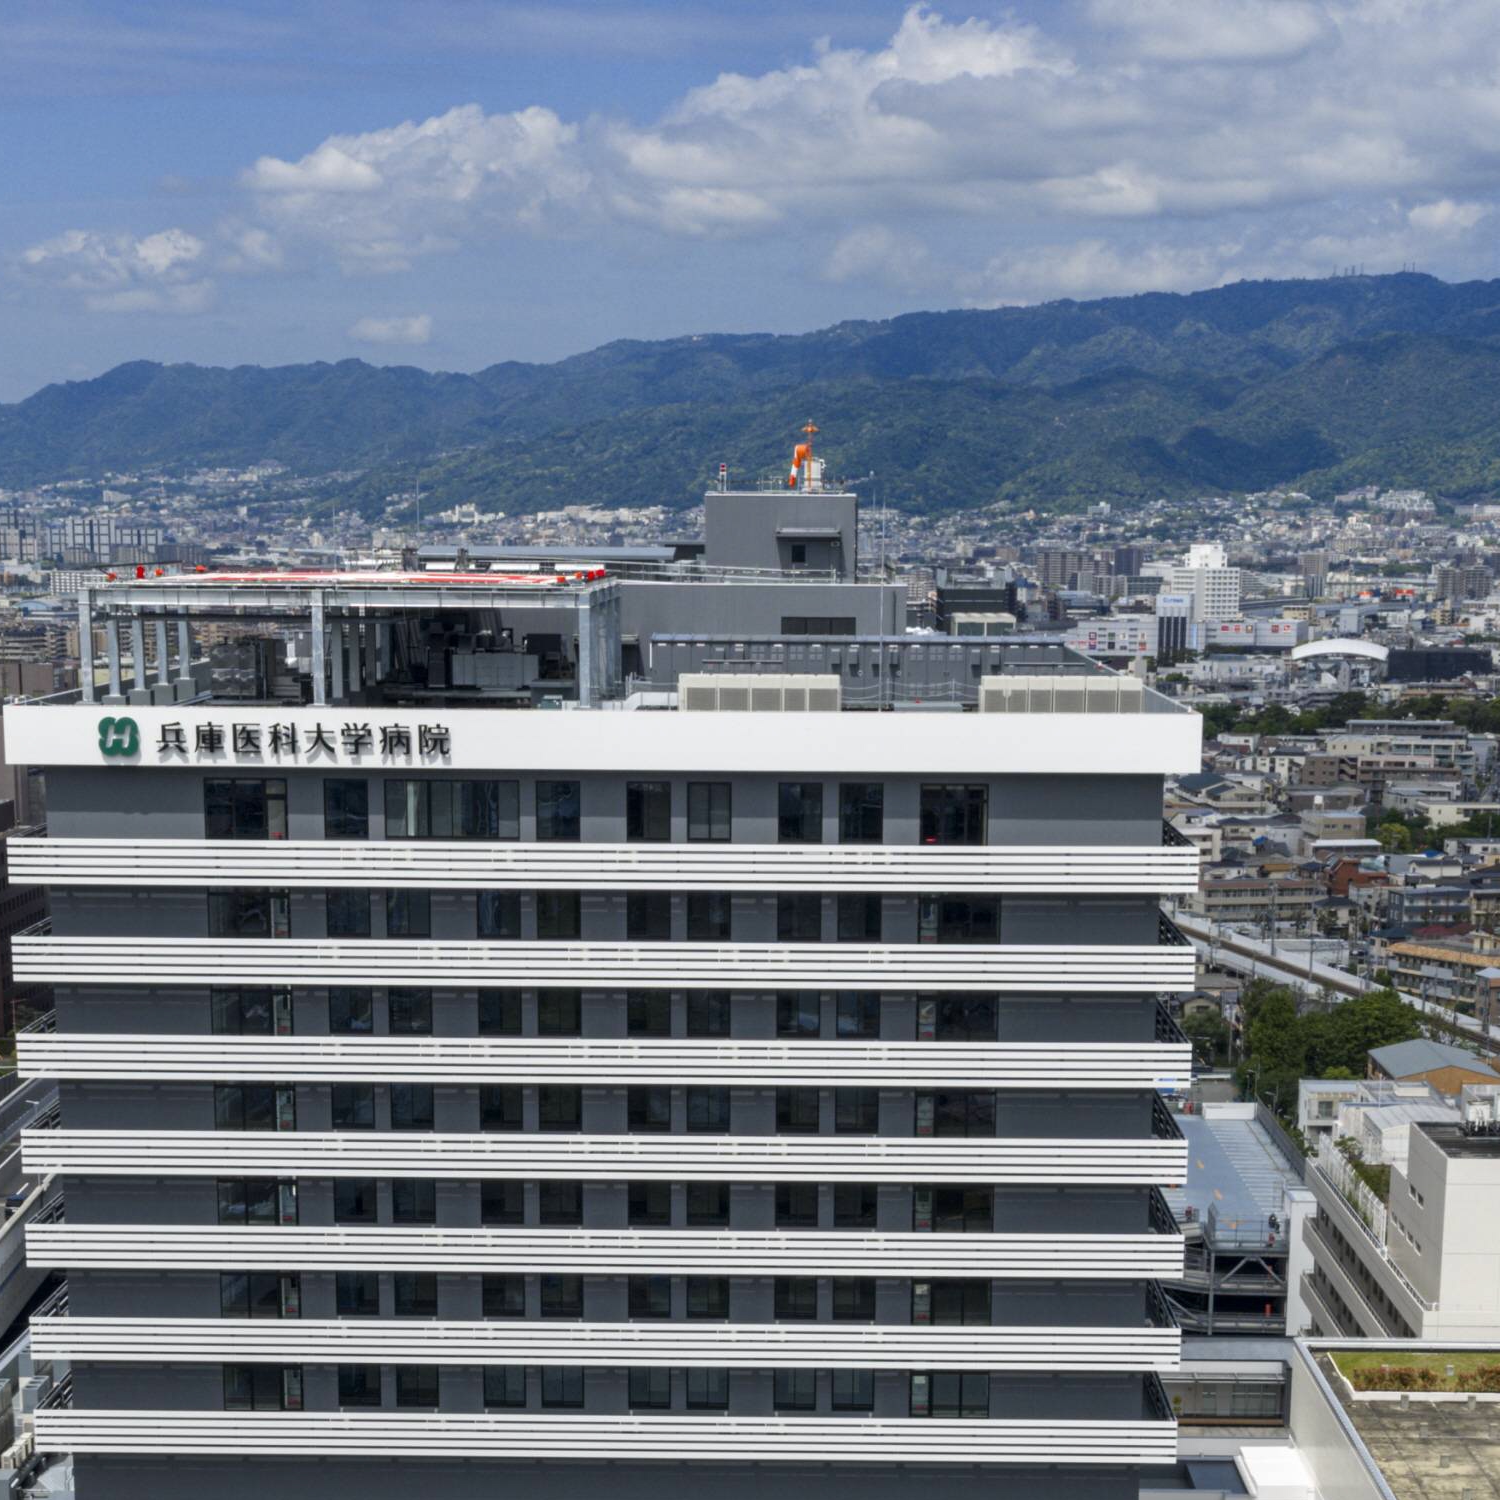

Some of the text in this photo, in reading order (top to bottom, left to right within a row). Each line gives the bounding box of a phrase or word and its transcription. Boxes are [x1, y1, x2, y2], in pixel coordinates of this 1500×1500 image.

[156, 721, 452, 756] 兵庫医科大学病院
